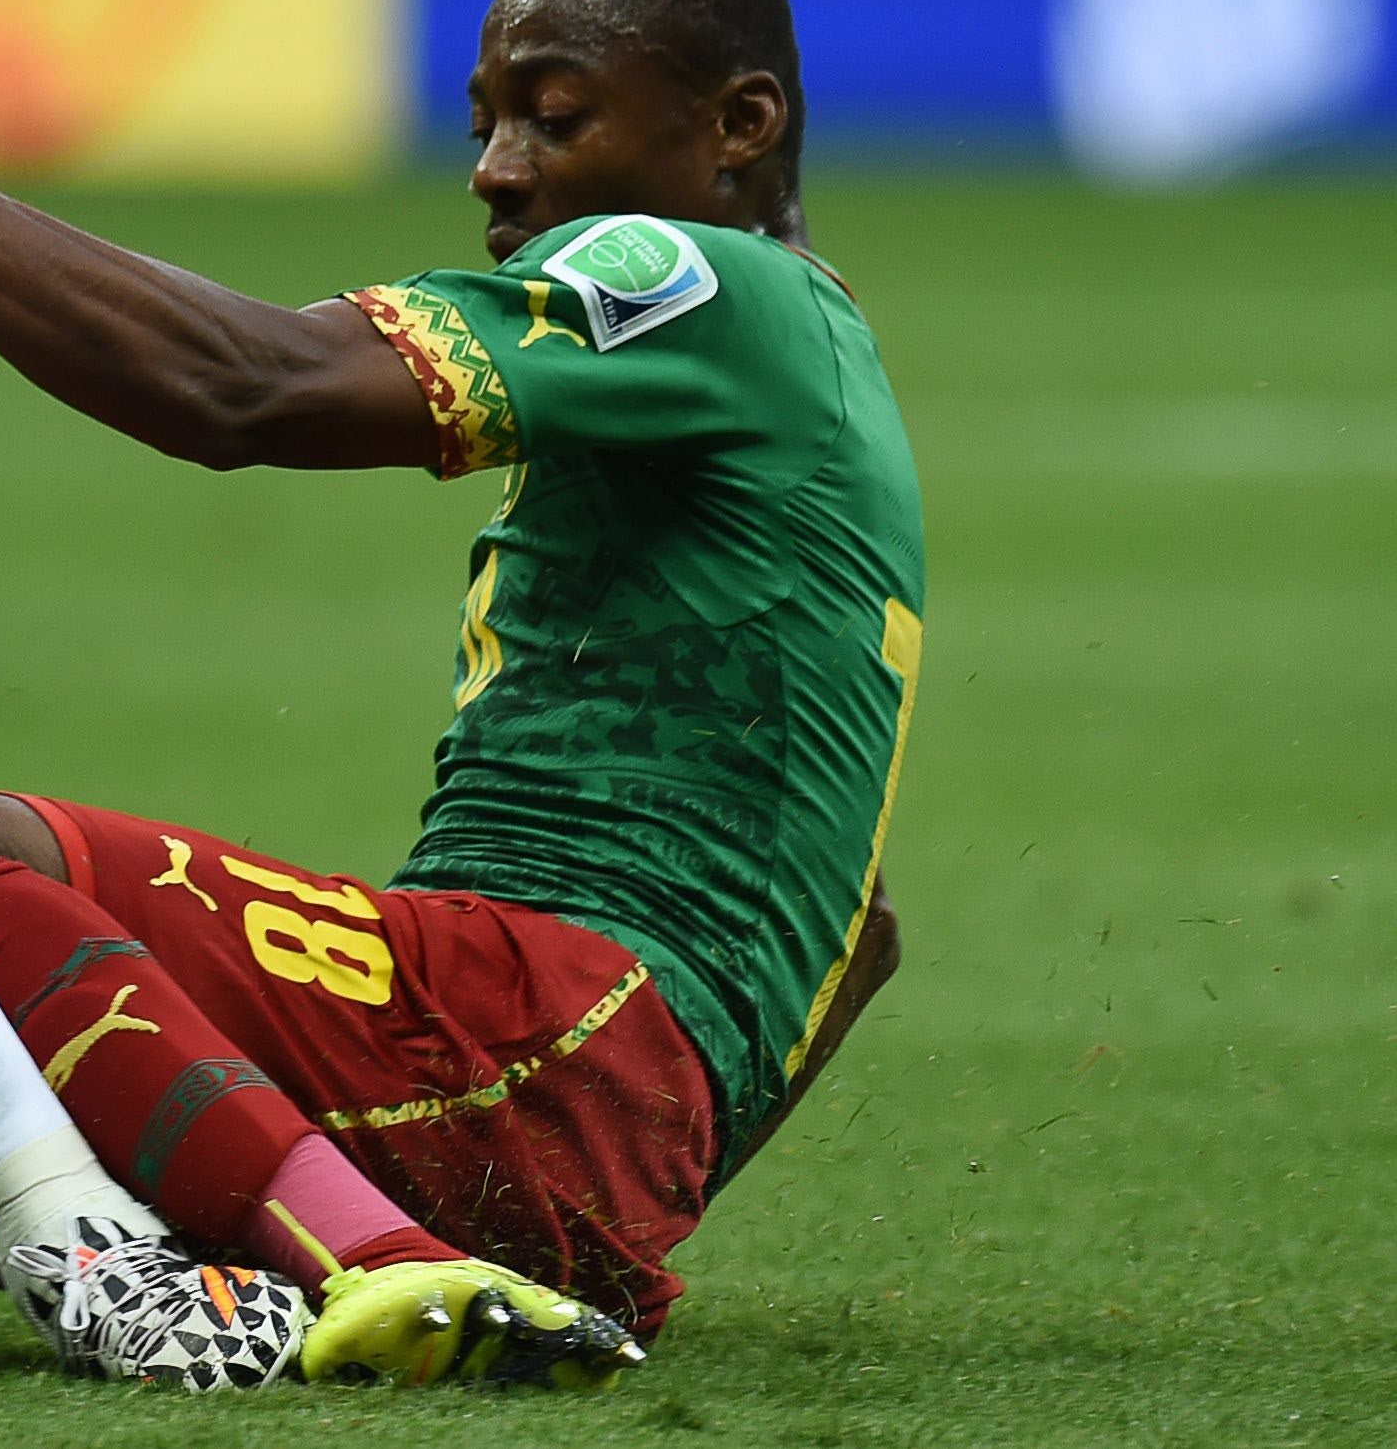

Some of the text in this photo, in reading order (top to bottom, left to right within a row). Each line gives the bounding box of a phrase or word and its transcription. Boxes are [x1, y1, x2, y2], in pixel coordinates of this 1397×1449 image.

[612, 228, 661, 275] FOR HOPE
[621, 225, 671, 272] FOOTBALL
[602, 296, 619, 326] FIFA
[219, 854, 394, 1006] 18
